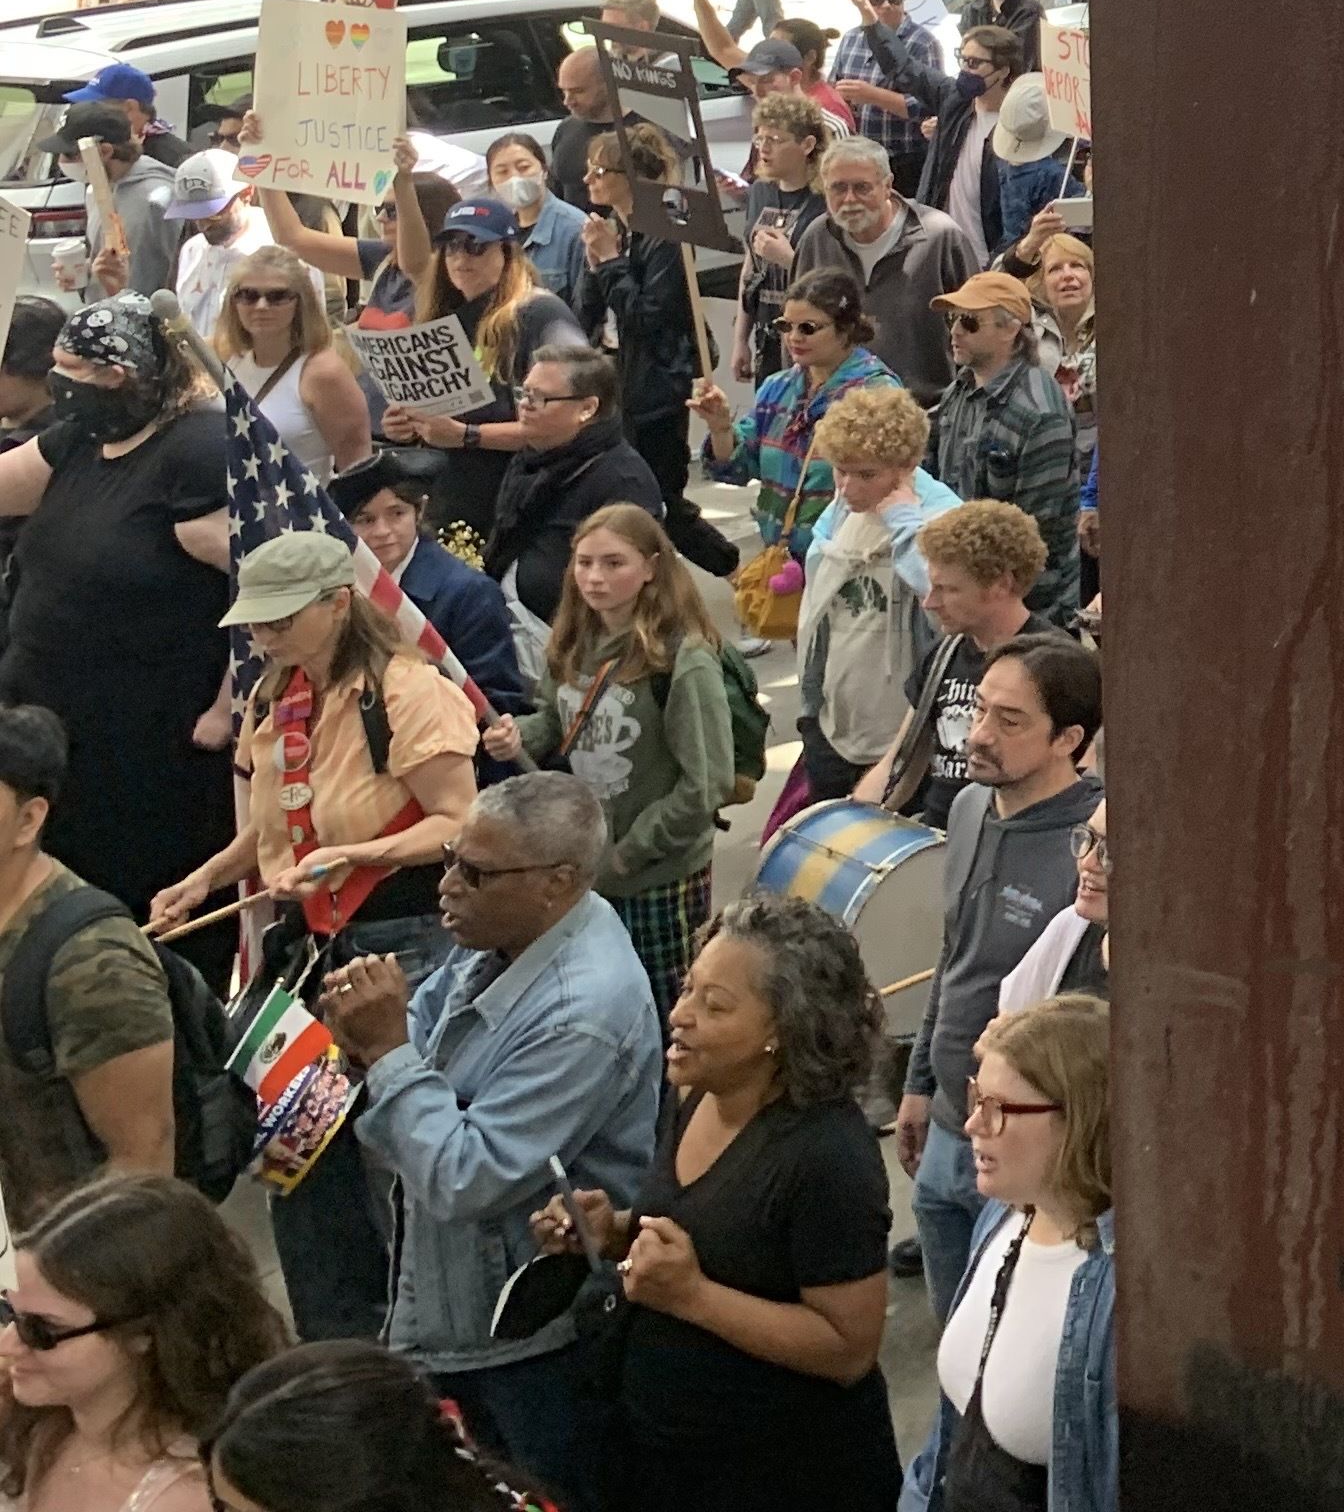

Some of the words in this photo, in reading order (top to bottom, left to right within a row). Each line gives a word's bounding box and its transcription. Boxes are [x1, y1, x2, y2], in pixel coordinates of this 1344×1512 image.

[297, 61, 391, 101] LIBERTY
[611, 60, 632, 81] NO
[635, 65, 677, 89] KINGS
[294, 118, 390, 153] JUSTICE
[272, 156, 314, 183] FOR
[326, 159, 367, 190] ALL
[369, 343, 461, 383] GAINST
